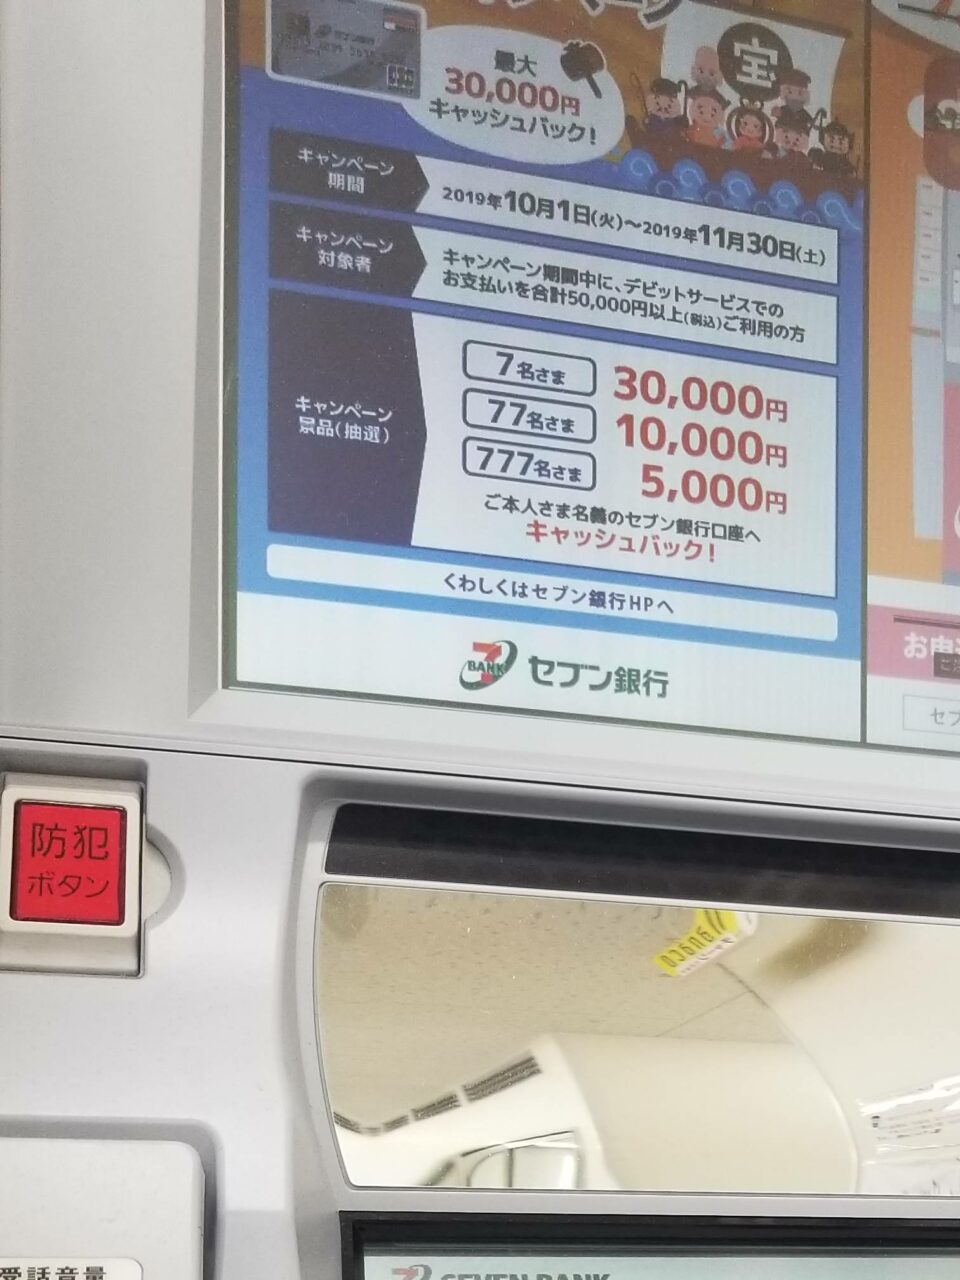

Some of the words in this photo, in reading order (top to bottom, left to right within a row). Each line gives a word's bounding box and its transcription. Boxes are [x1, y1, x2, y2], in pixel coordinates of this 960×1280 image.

[494, 50, 538, 77] 最大
[734, 38, 779, 88] 宝
[445, 67, 580, 116] 30,000円
[297, 148, 395, 176] キャンペーン
[328, 173, 365, 194] 期間
[296, 226, 394, 254] キャンペーン
[318, 250, 372, 274] 対象者
[496, 351, 566, 387] 7名さま
[295, 396, 393, 423] キャンペーン
[613, 365, 788, 423] 30,000円
[487, 398, 576, 435] 77名さま
[614, 413, 788, 468] 10,000円
[476, 446, 582, 482] 777名さま
[641, 463, 788, 515] 5,000円
[528, 655, 669, 698] セブン銀行
[31, 822, 109, 860] 防犯
[28, 871, 109, 898] ボタン
